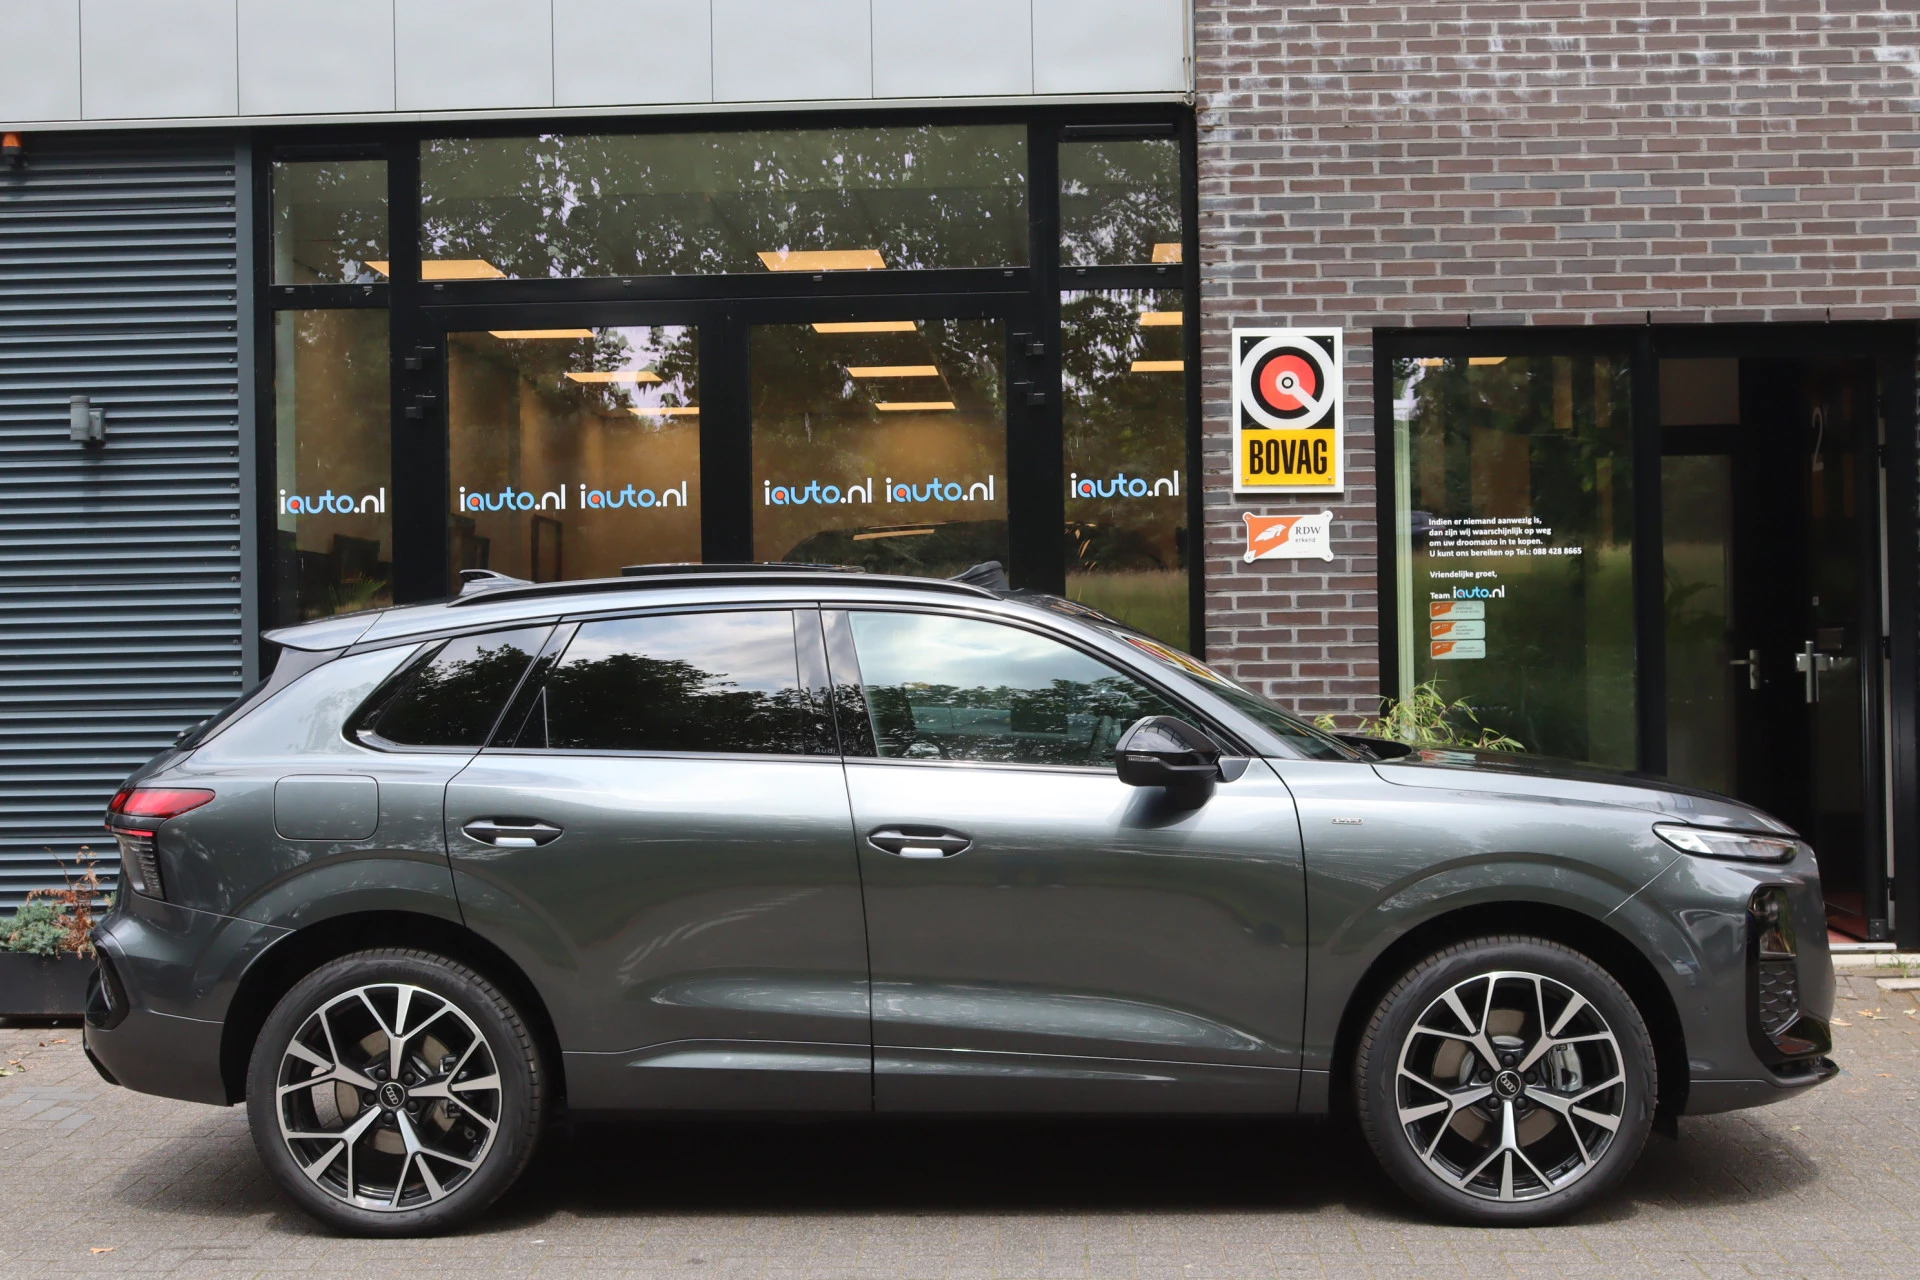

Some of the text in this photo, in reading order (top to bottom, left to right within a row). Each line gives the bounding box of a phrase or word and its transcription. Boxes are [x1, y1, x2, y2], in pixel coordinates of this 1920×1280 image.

[1249, 438, 1328, 475] BOVAG
[764, 475, 994, 505] iauto.nl iauto.nl
[1070, 470, 1180, 498] iauto.nl
[280, 487, 385, 514] iauto.nl
[459, 481, 687, 512] iauto.nl iauto.nl
[1464, 517, 1496, 525] niemand
[1498, 517, 1532, 525] aanwezig
[1534, 516, 1542, 524] is,
[1295, 526, 1321, 535] RDW
[1445, 529, 1458, 537] zijn
[1459, 528, 1471, 537] wij
[1472, 527, 1523, 536] waarschijnlijk
[1518, 538, 1543, 546] kopen.
[1564, 547, 1582, 555] 8665
[1430, 570, 1497, 579] Vriendelijke groet,
[1453, 585, 1505, 599] iauto.nl
